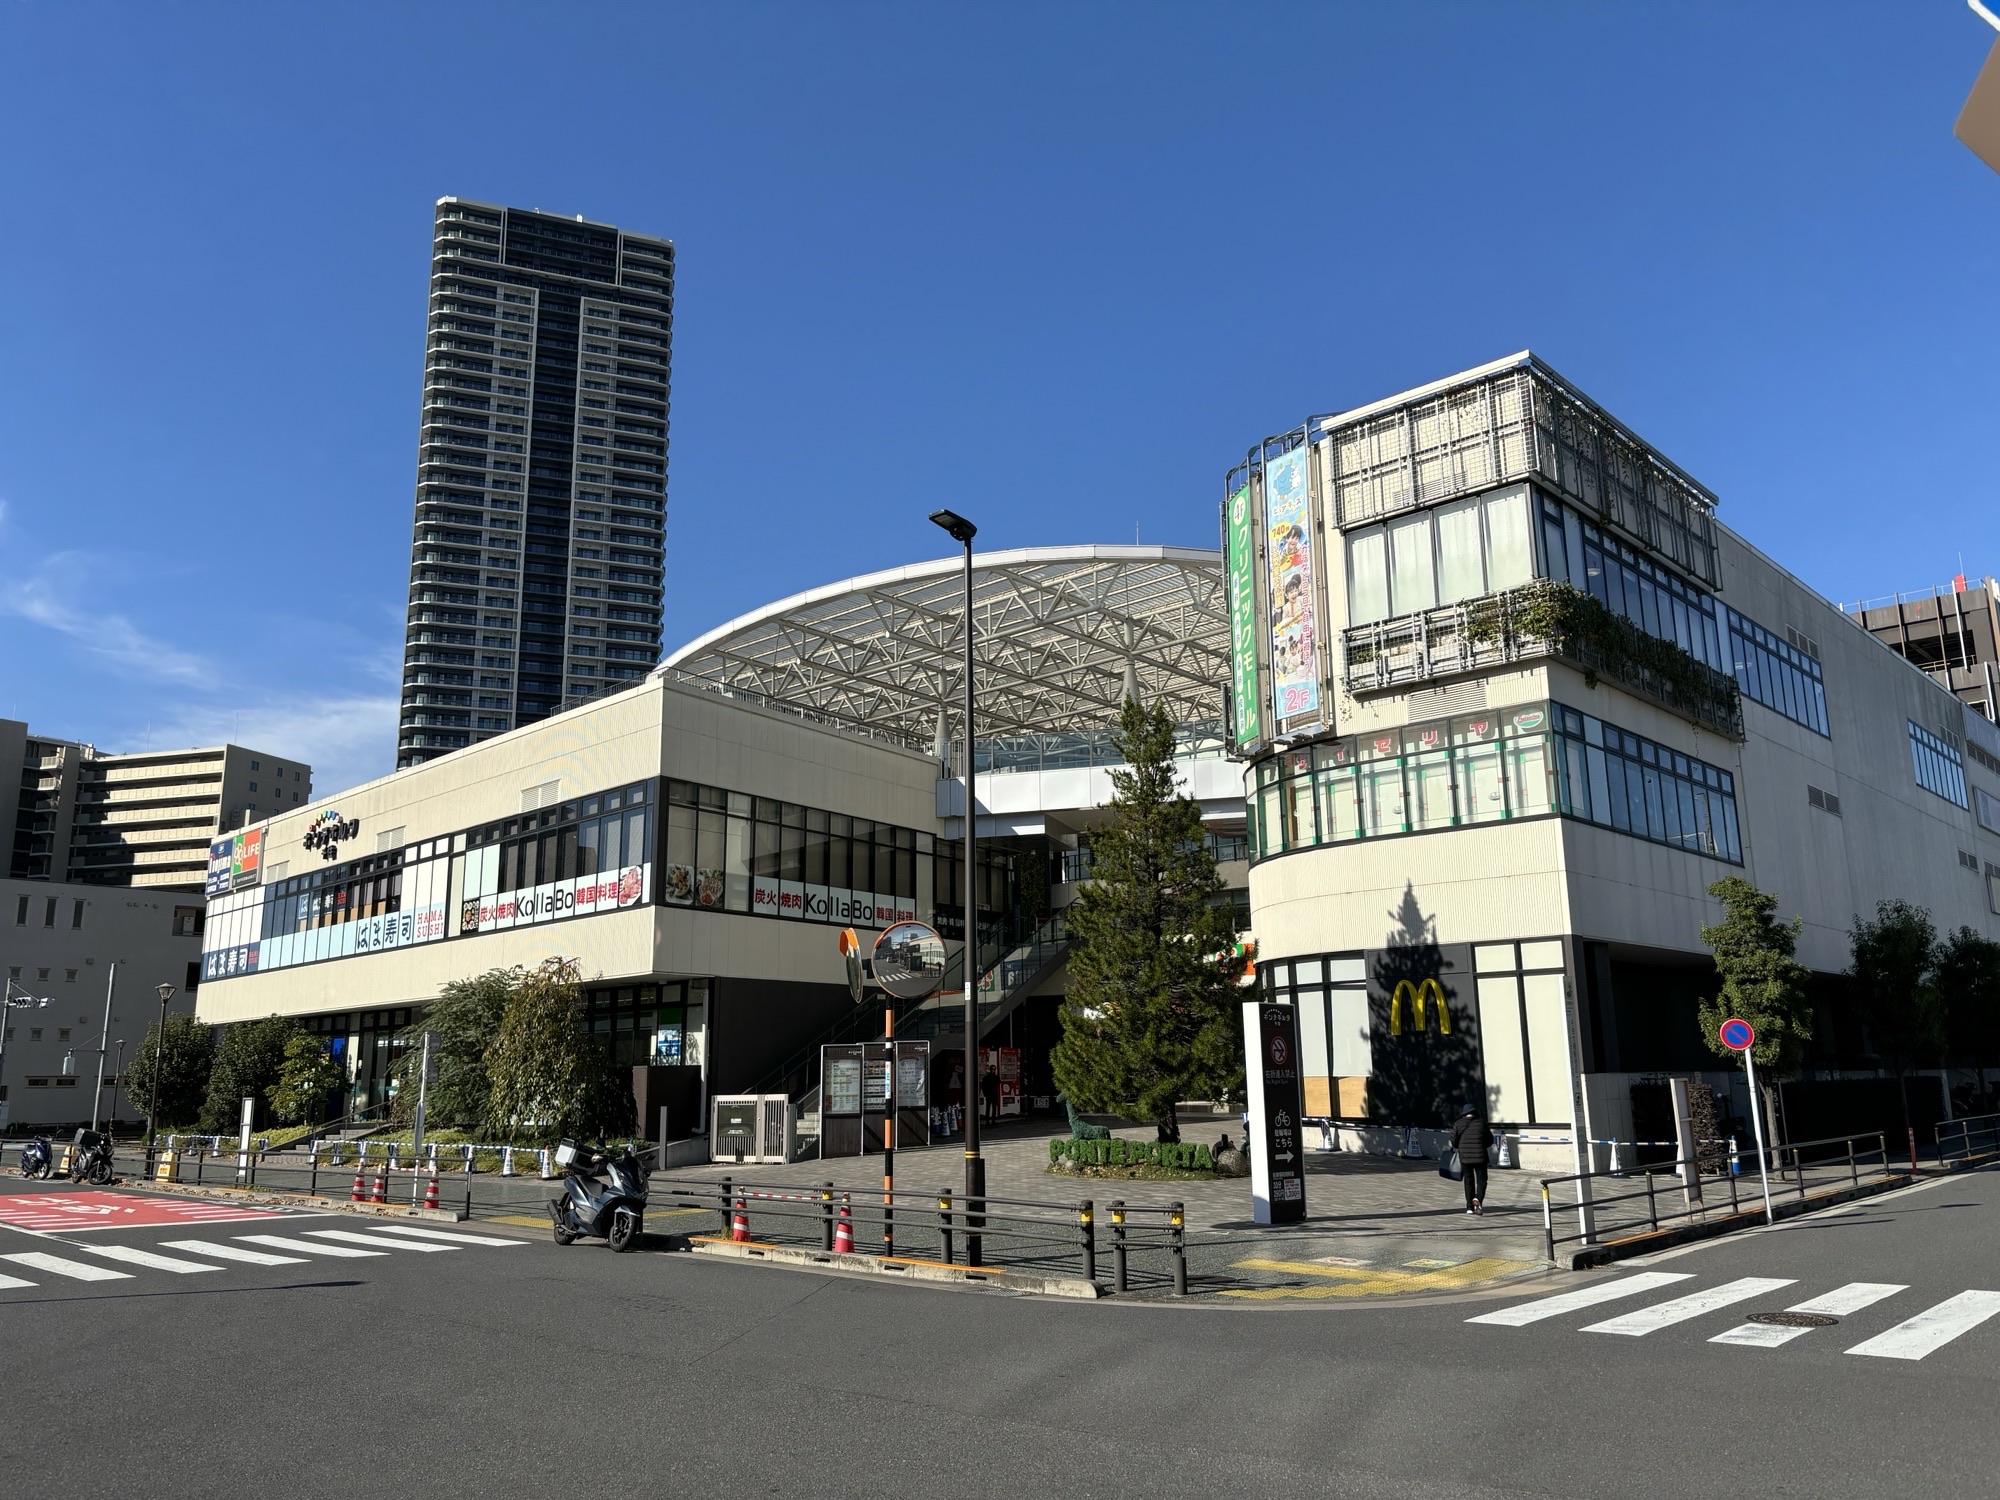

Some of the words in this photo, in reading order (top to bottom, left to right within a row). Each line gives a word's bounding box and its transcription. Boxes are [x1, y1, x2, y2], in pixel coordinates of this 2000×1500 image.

[1239, 523, 1256, 730] クリニックモール
[1285, 687, 1310, 713] 2F
[243, 842, 260, 859] LIFE
[516, 889, 574, 918] KollaBo
[576, 881, 618, 906] 韓国料理
[805, 892, 873, 921] KollaBo
[416, 922, 444, 938] SUSHI
[417, 909, 444, 925] HAMA
[357, 915, 412, 950] はま寿司
[207, 948, 248, 977] はま寿司
[1275, 1137, 1293, 1147] こちら
